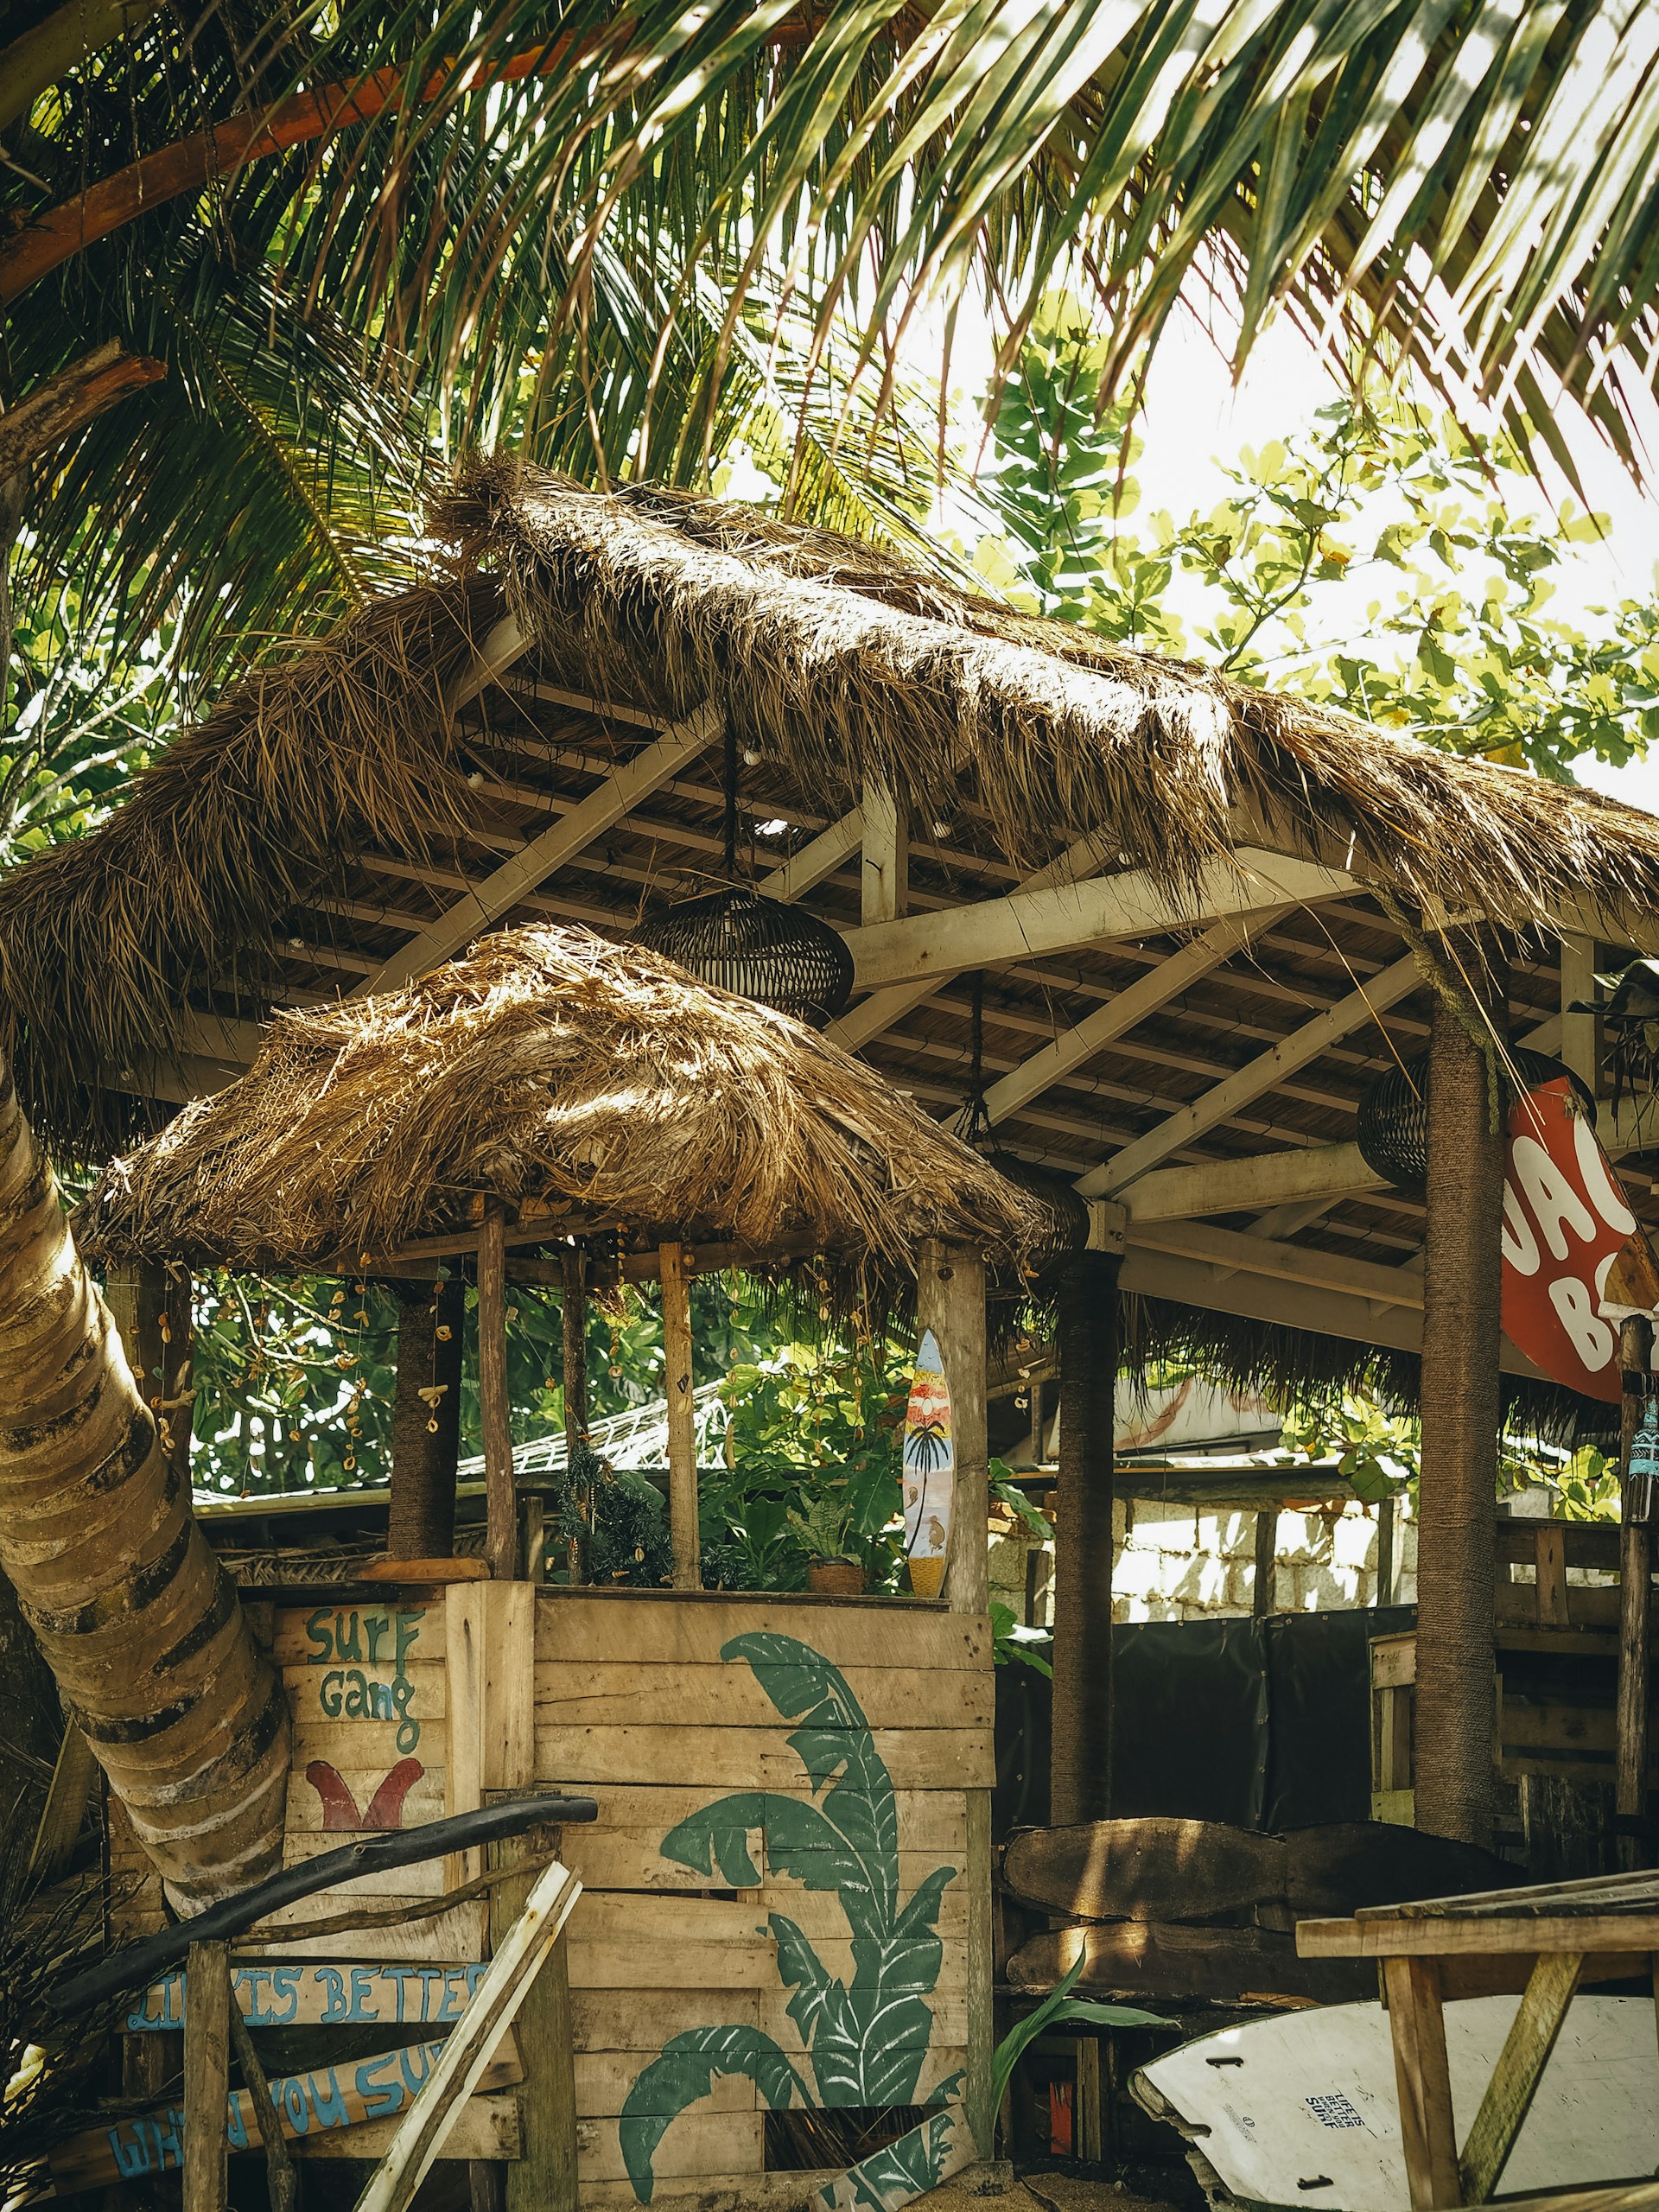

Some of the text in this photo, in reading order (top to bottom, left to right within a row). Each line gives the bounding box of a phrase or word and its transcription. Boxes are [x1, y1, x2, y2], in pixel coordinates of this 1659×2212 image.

[320, 1669, 421, 1755] Gang
[233, 1967, 303, 2025] IS
[1305, 2097, 1338, 2129] SURF
[1317, 2096, 1345, 2128] WHEN YOU
[1325, 2095, 1355, 2127] BETTER
[1334, 2094, 1365, 2126] LIFE IS
